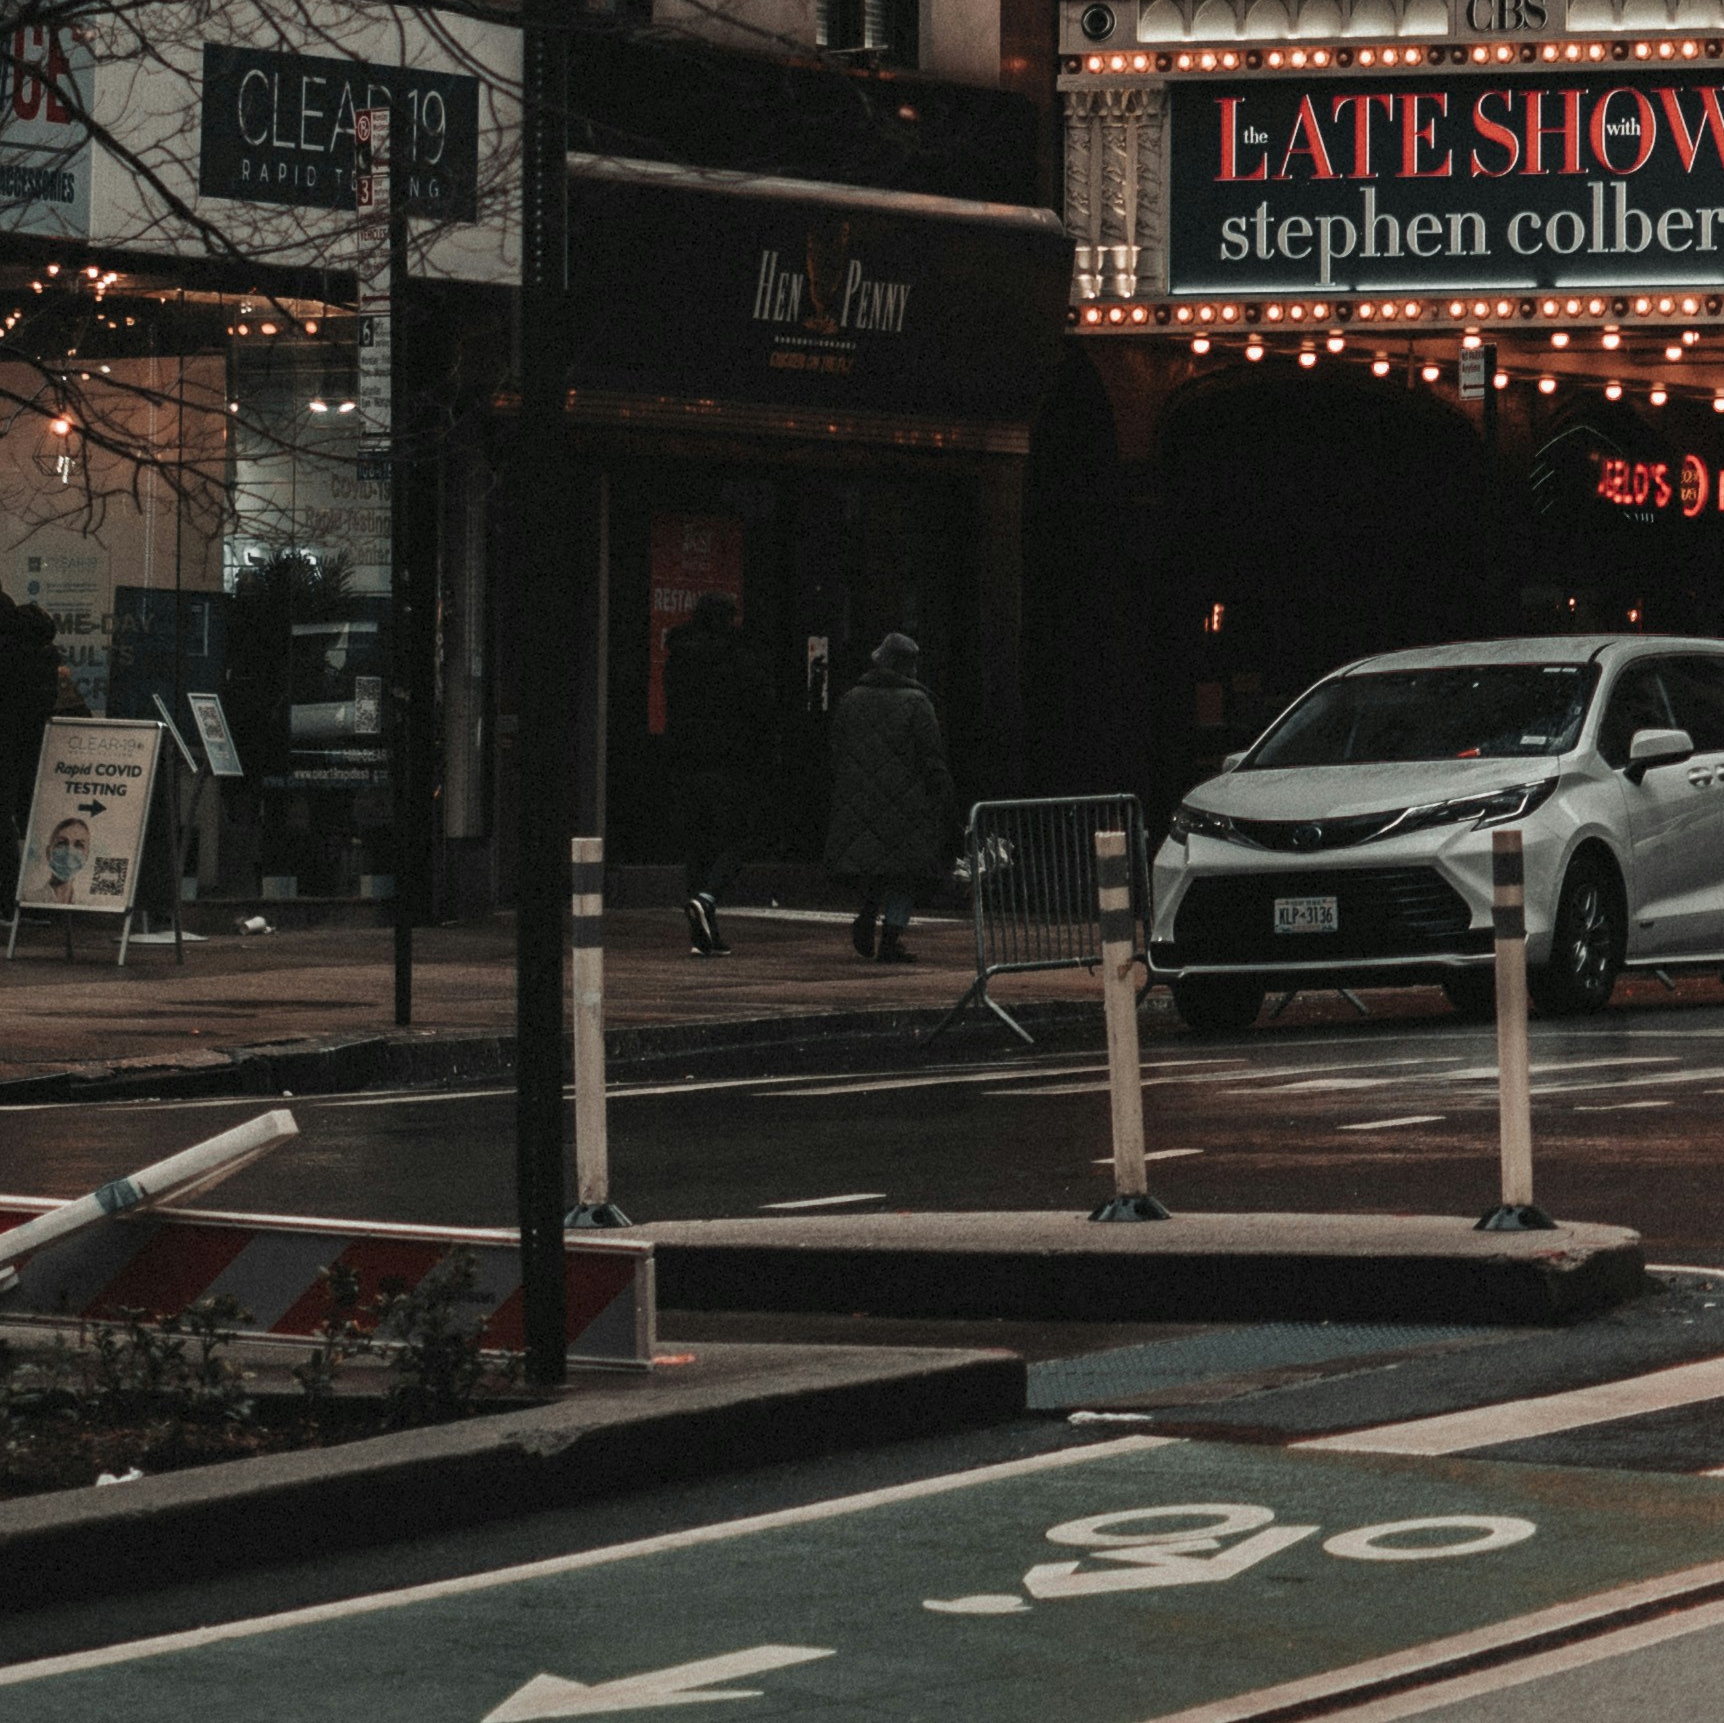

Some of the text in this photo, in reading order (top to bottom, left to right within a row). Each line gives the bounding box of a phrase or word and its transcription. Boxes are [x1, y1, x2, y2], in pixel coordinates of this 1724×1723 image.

[1213, 92, 1451, 182] LATE
[1242, 126, 1269, 146] the
[1606, 117, 1641, 138] with
[241, 158, 318, 188] RAPID
[1220, 187, 1490, 288] stephen
[54, 761, 142, 778] Rapid COVID
[65, 781, 128, 797] TESTING
